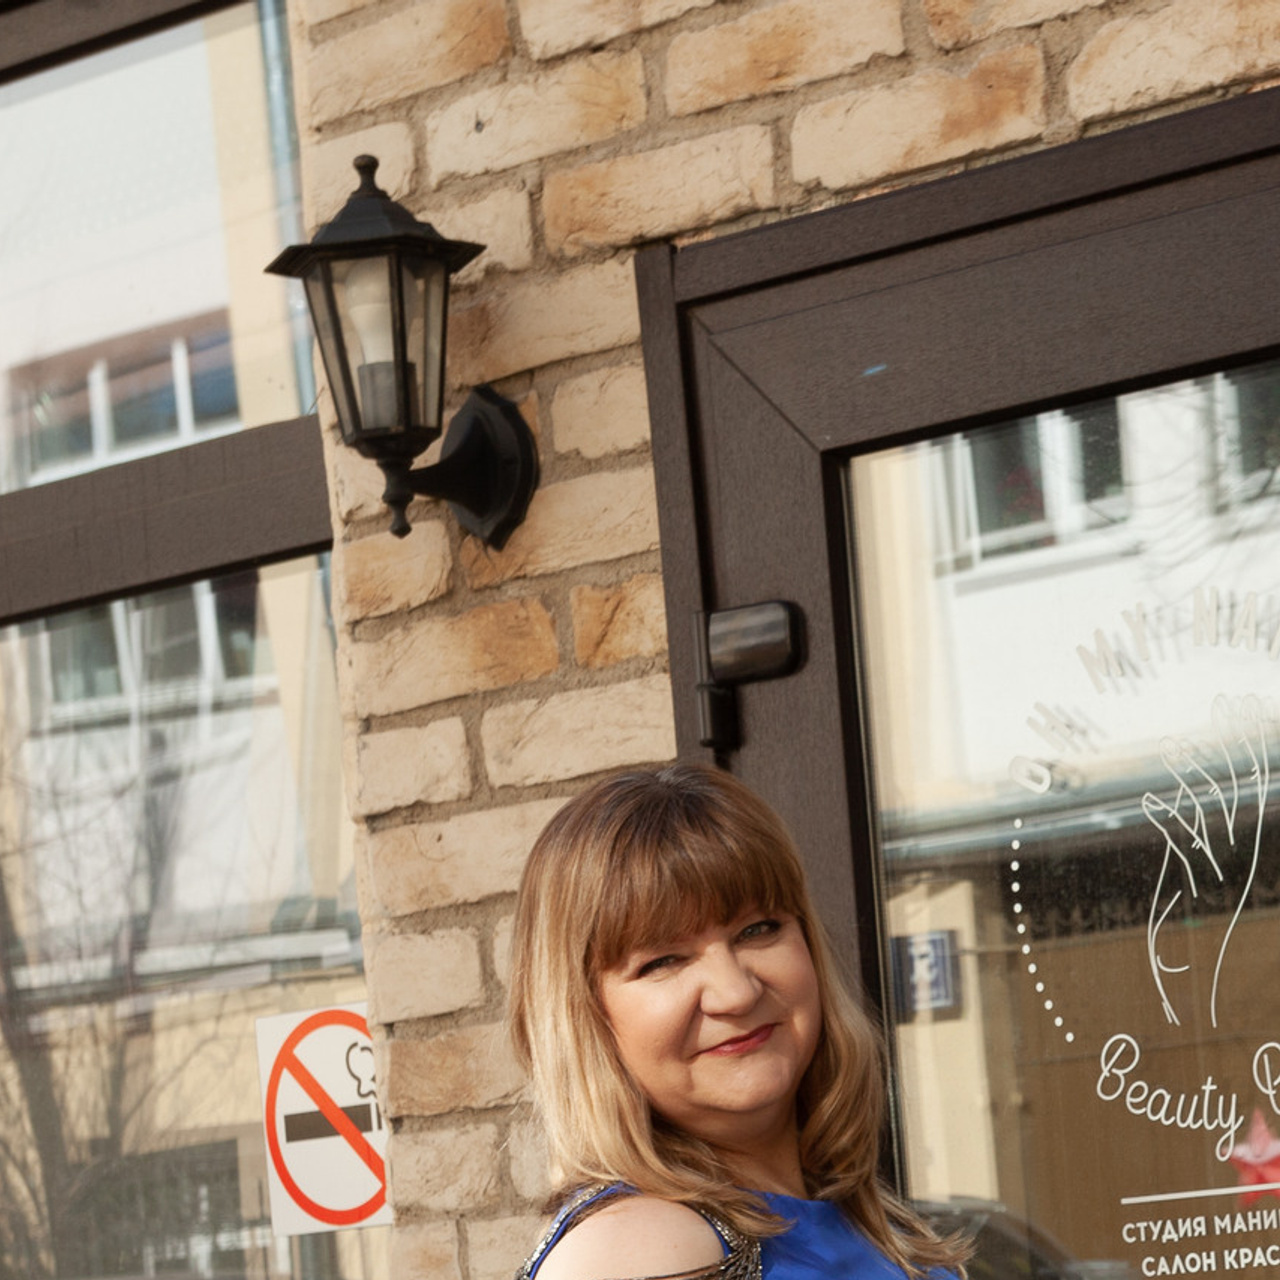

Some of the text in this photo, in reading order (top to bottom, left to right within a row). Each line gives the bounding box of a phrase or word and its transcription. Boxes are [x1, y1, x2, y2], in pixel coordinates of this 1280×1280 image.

[1075, 602, 1150, 693] MY
[1096, 1033, 1245, 1162] Beauty
[1121, 1216, 1207, 1243] СТУДИЯ
[1141, 1251, 1216, 1277] САЛОН
